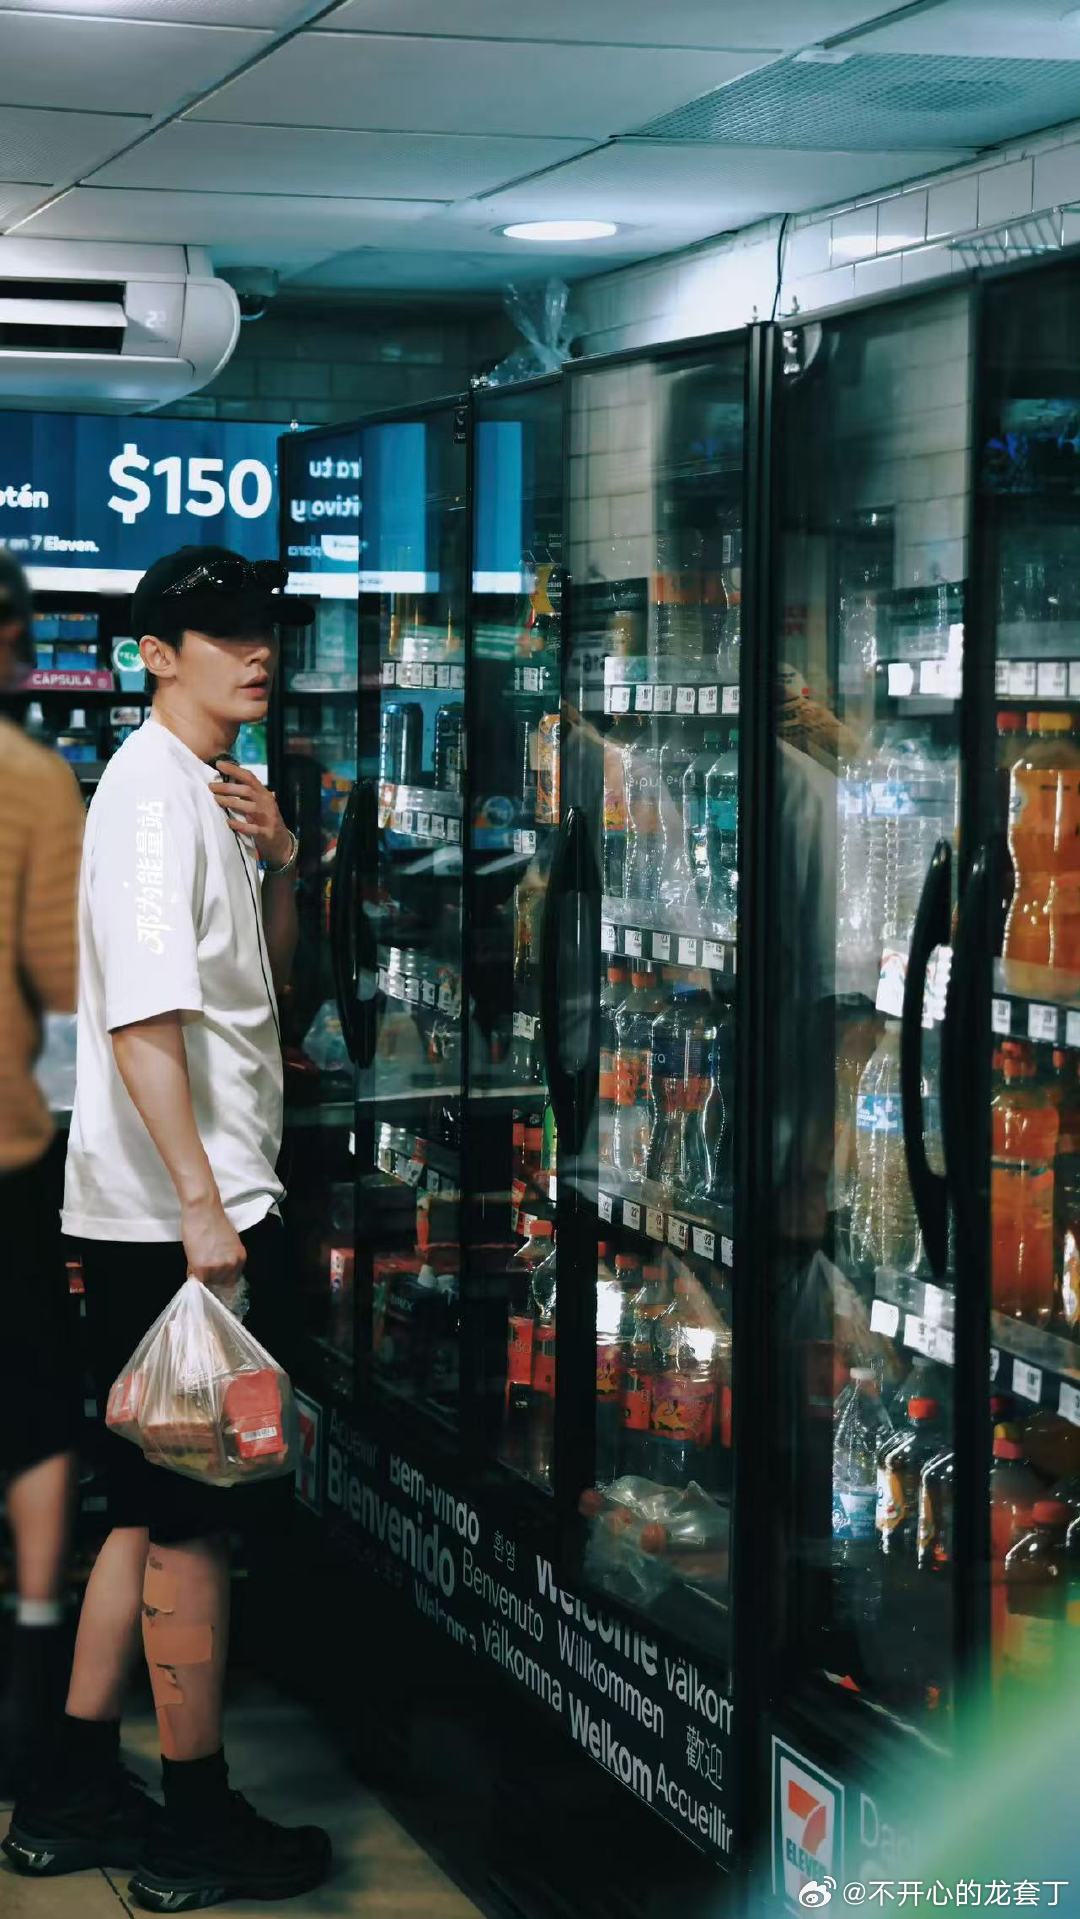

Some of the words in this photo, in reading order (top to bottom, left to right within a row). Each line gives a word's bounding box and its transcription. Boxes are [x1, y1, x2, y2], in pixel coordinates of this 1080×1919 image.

[107, 443, 273, 525] $150
[327, 1443, 455, 1598] Bienvenido
[390, 1453, 480, 1545] Bem-vindo
[462, 1546, 545, 1643] Benvenuto
[481, 1618, 563, 1714] välkomna
[557, 1619, 665, 1739] Willkommen
[569, 1690, 654, 1803] Welkom
[685, 1724, 724, 1792] 歡迎
[655, 1762, 734, 1854] Accueillir
